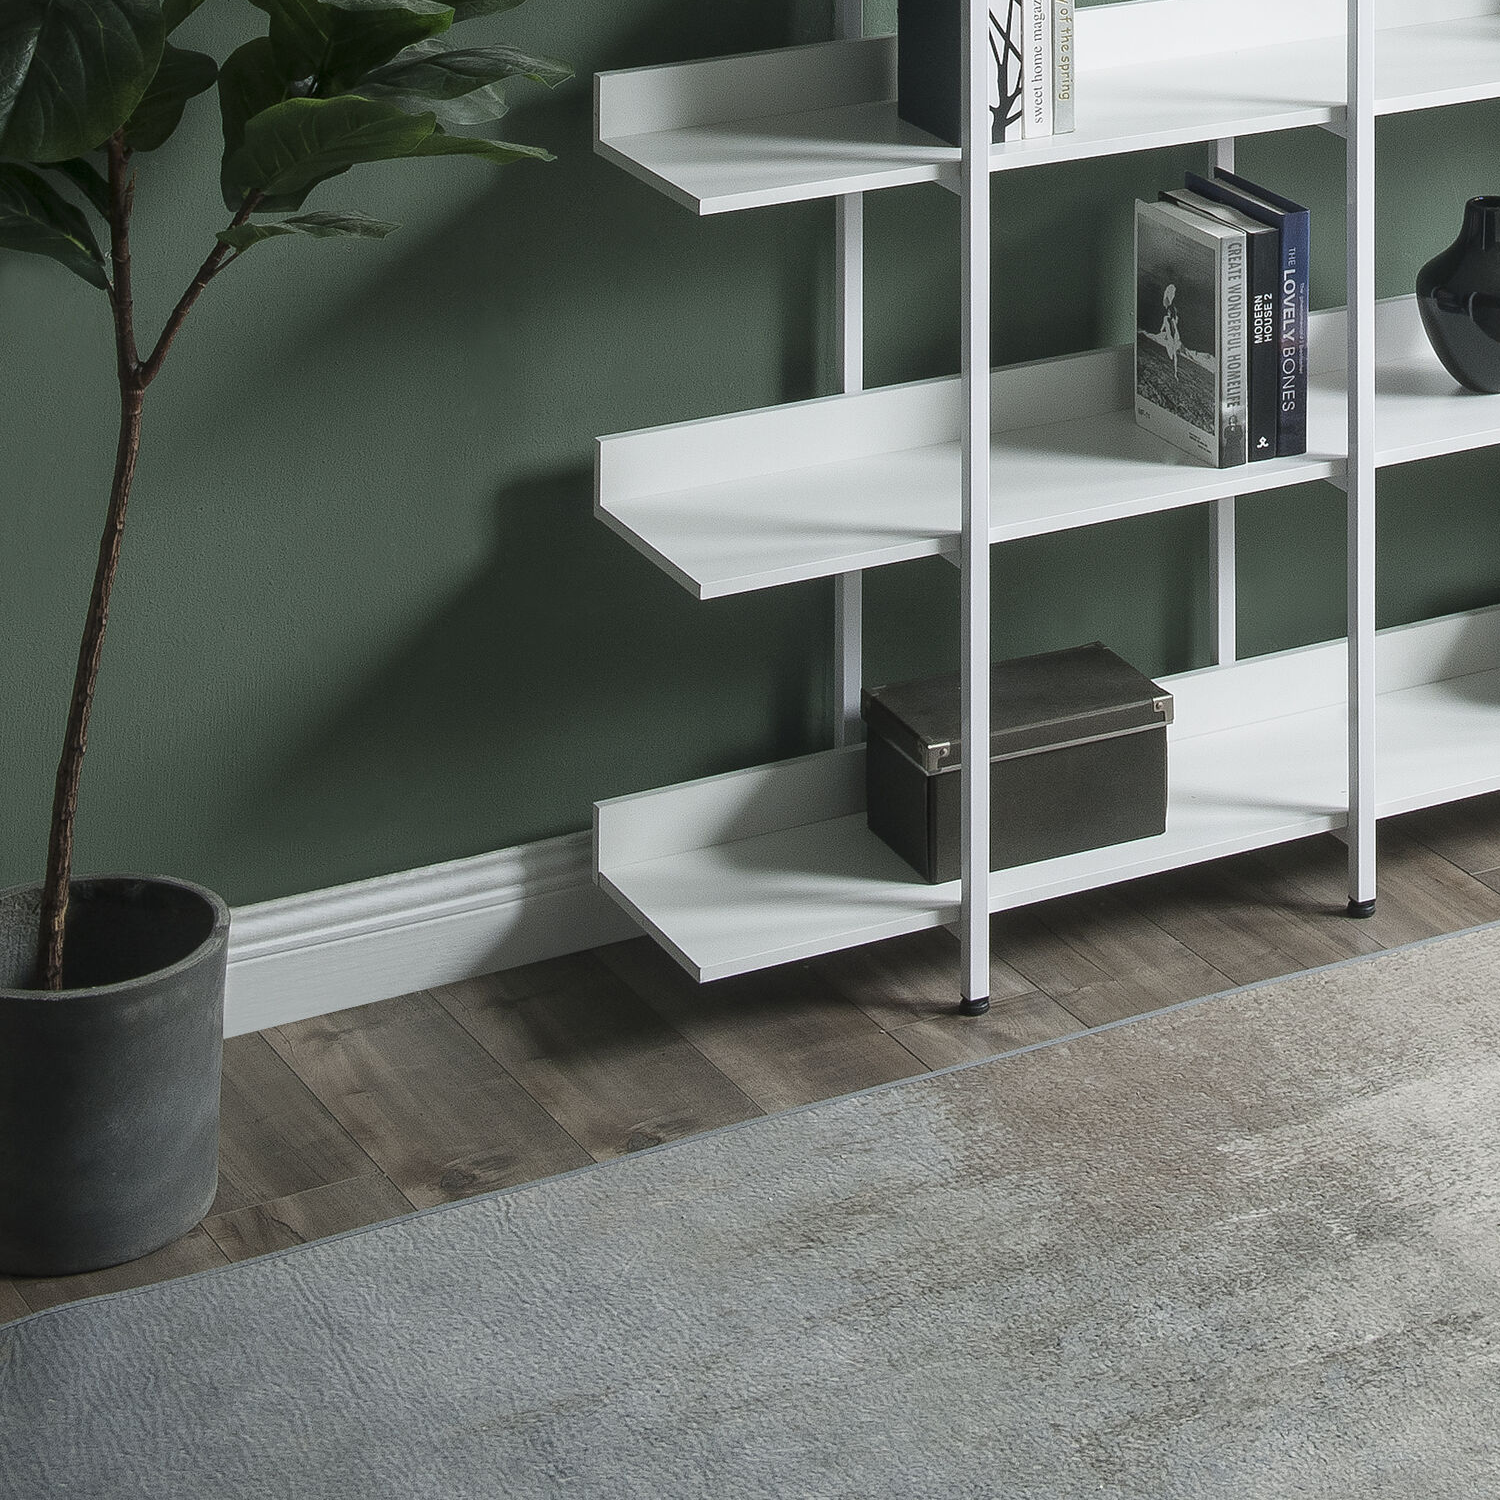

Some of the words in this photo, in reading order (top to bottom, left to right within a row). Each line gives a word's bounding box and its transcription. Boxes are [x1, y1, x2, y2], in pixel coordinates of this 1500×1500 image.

[1061, 9, 1073, 23] of
[1061, 27, 1073, 53] the
[1031, 45, 1043, 82] home
[1058, 57, 1073, 101] spring
[1033, 85, 1043, 124] sweet
[1227, 242, 1242, 281] CREATE
[1288, 247, 1296, 266] THE
[1227, 284, 1241, 351] WONDERFUL
[1254, 295, 1263, 344] MODERN
[1264, 302, 1273, 342] HOUSE
[1282, 268, 1296, 344] LOVELY
[1226, 354, 1241, 408] HOMELIFE
[1282, 348, 1296, 412] BONES
